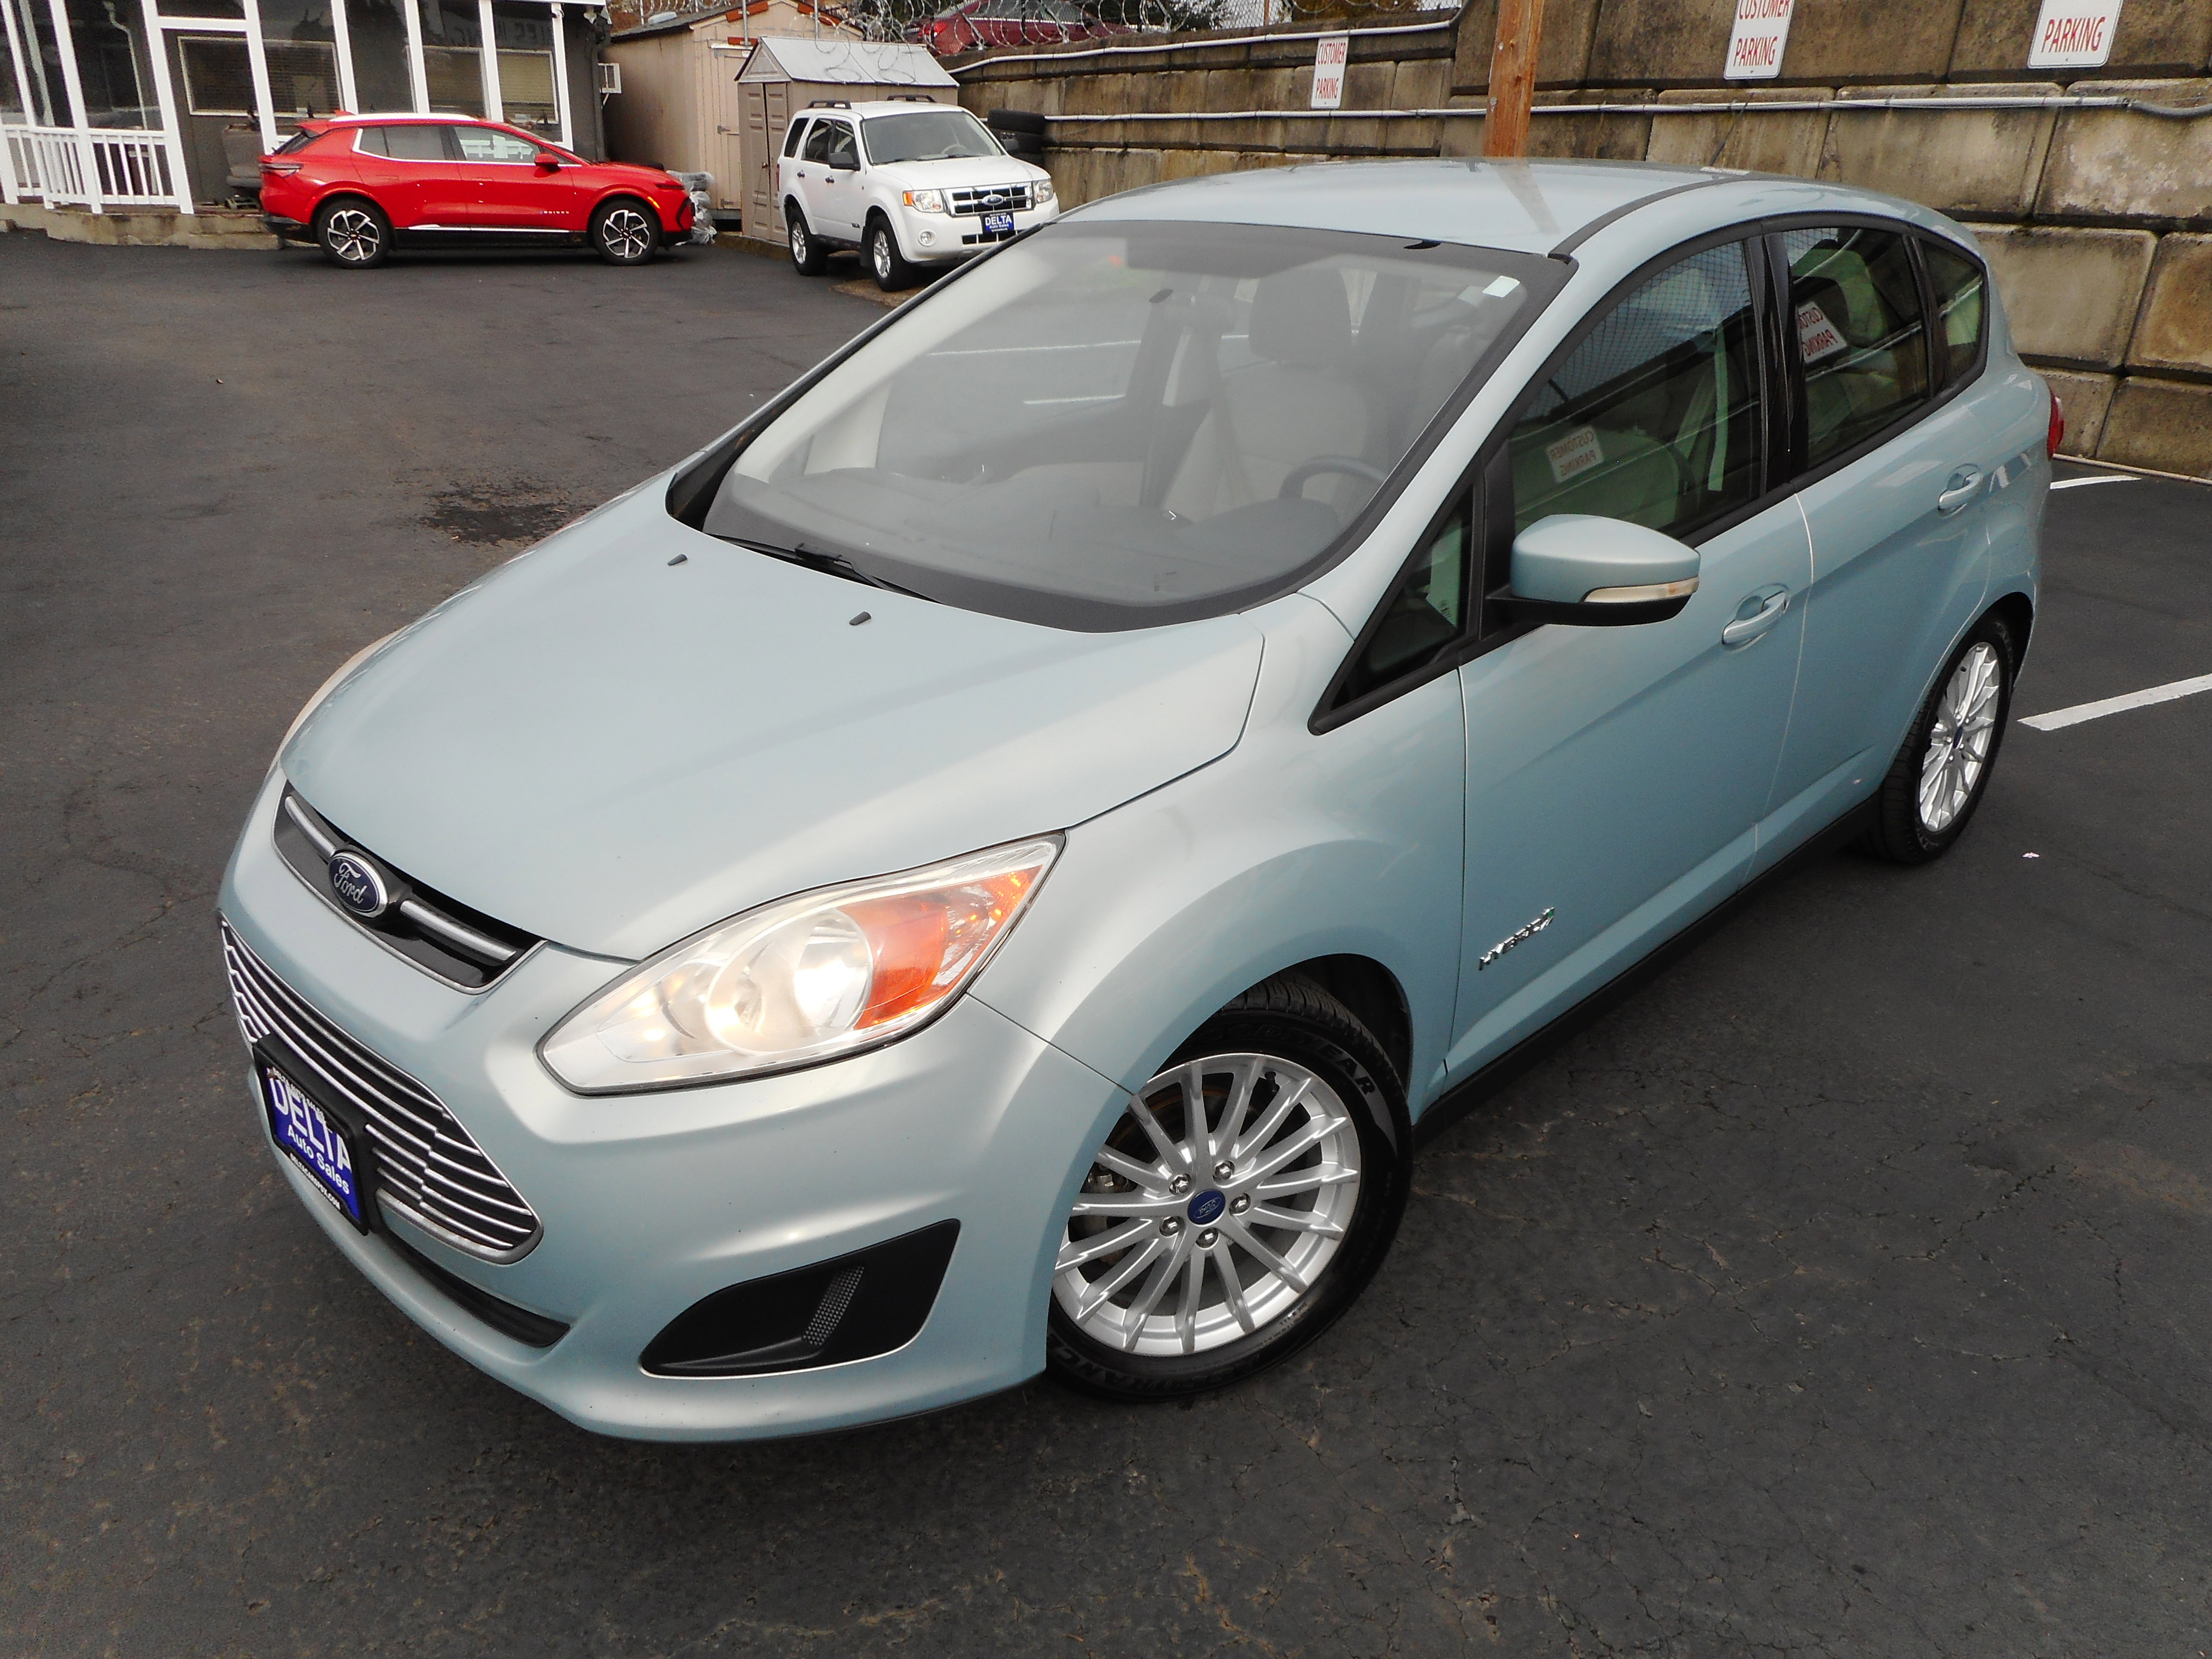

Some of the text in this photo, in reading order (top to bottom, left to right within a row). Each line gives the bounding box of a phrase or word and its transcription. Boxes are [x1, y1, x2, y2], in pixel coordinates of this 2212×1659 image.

[1739, 0, 1790, 19] CUSTOMER
[1733, 36, 1778, 67] PARKING
[2041, 16, 2106, 53] PARKING
[1317, 42, 1346, 64] CUSTOMER
[1315, 77, 1339, 99] PARKING
[985, 215, 1012, 226] DELTA
[334, 862, 368, 904] Ford
[1188, 1023, 1376, 1095] OODYEAR
[269, 1078, 352, 1173] DELTA
[287, 1124, 350, 1195] Auto Sales
